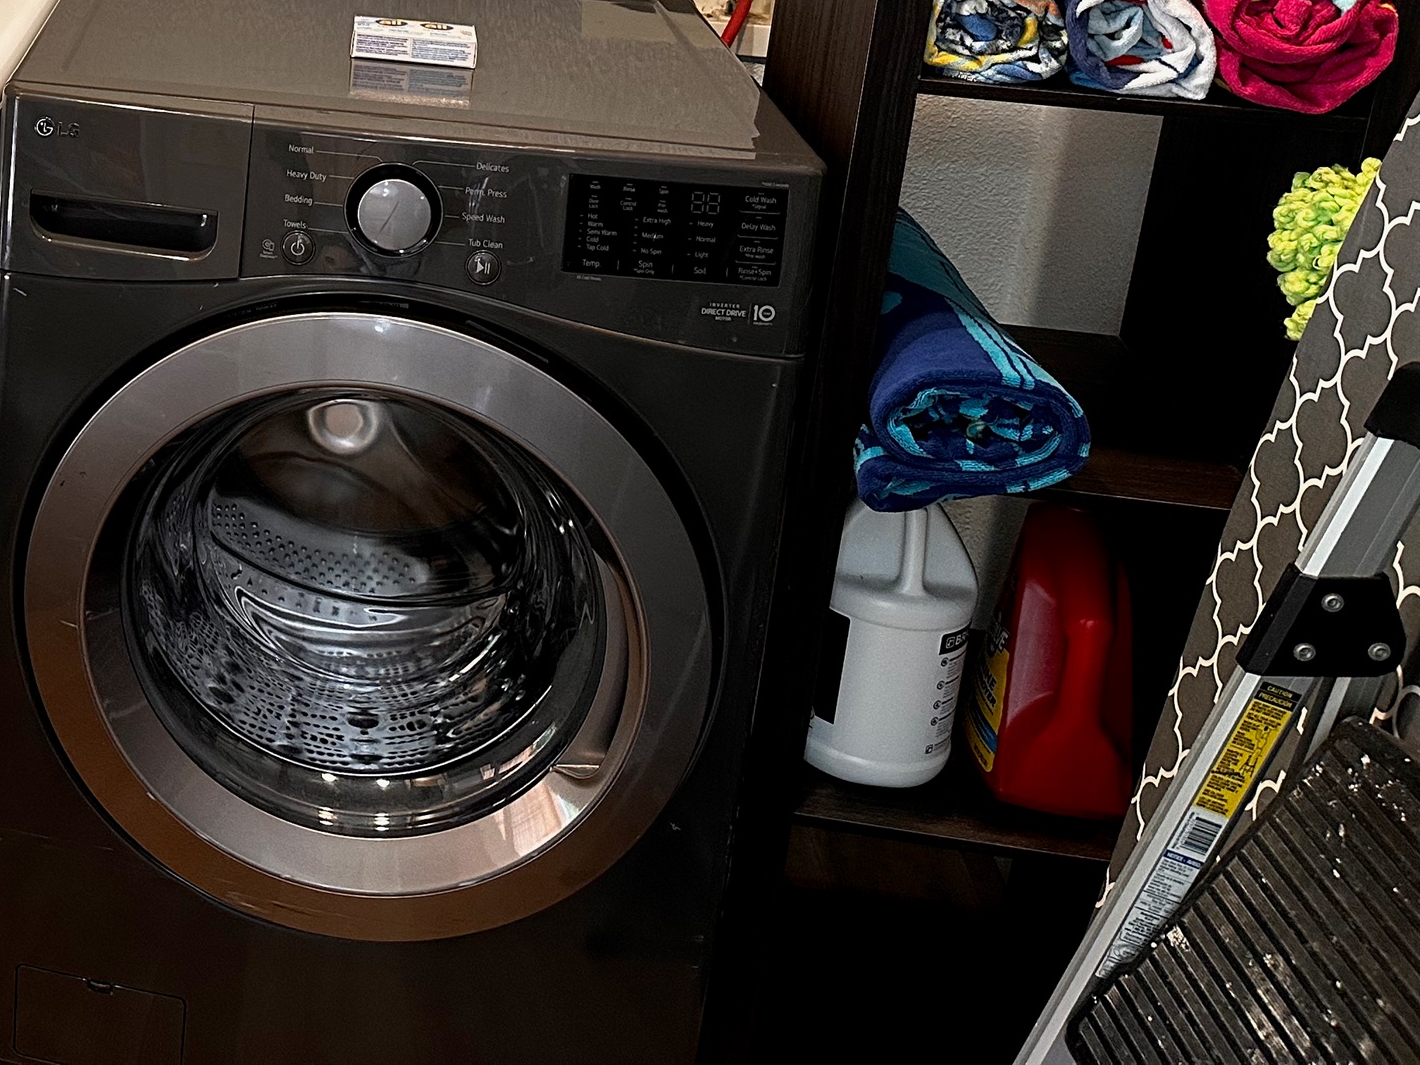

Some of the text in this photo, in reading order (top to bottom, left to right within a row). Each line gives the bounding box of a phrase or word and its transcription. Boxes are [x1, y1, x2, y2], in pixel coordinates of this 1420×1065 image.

[288, 144, 314, 154] Normal
[476, 162, 510, 173] Delicates
[286, 169, 327, 182] Heavy Duty
[487, 188, 508, 199] Press
[284, 194, 313, 207] Bedding
[745, 196, 760, 204] Cold
[461, 212, 506, 224] Speed Wash
[658, 217, 672, 225] High
[283, 219, 307, 229] Towels
[697, 220, 714, 228] Heavy
[741, 222, 758, 232] Delay
[468, 238, 504, 250] Tub Clean
[650, 248, 663, 256] Spin
[739, 245, 774, 254] Extra Rinse
[695, 251, 709, 259] Light
[638, 260, 653, 269] Spin
[694, 267, 707, 275] Soil
[701, 307, 747, 317] DIRECT DRIVE
